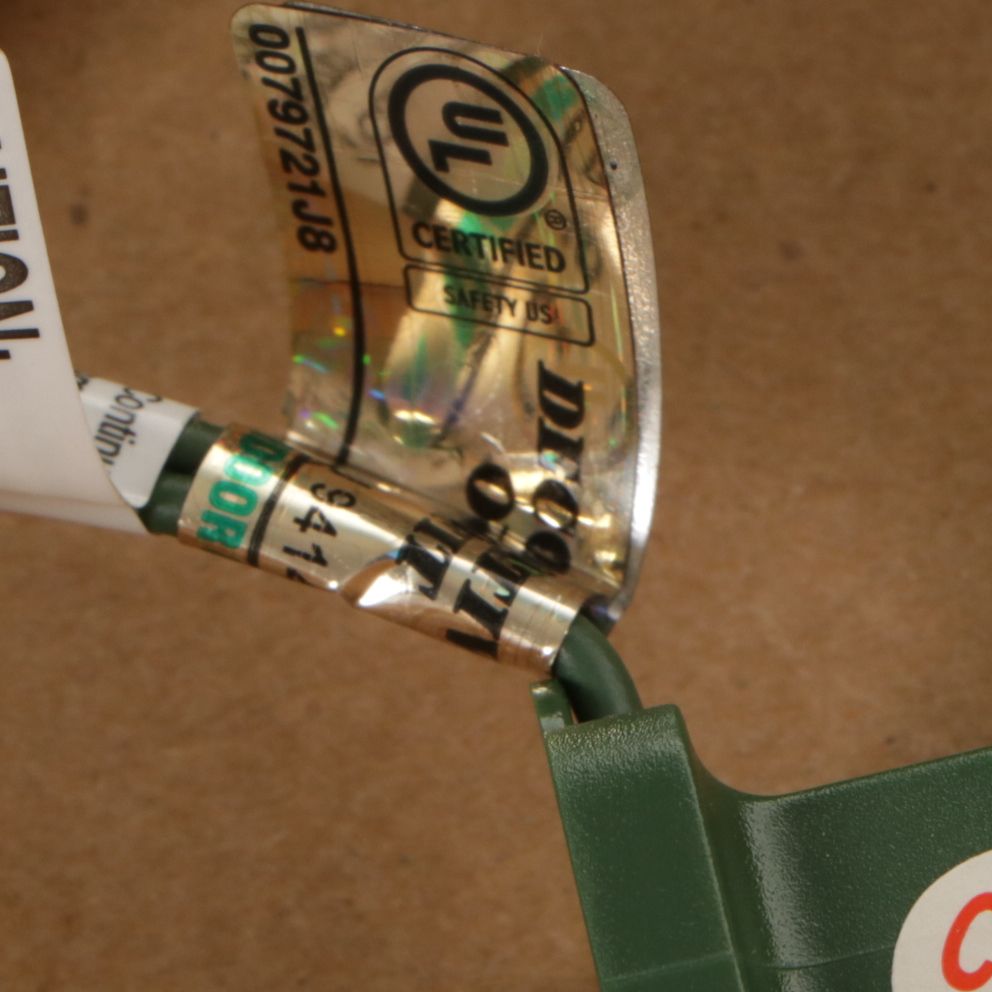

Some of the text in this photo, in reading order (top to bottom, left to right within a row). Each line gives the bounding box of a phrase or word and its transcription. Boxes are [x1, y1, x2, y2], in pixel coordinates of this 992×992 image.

[249, 23, 338, 255] 0079721J8
[427, 101, 509, 173] UL
[411, 221, 566, 273] CERTIFIED
[443, 284, 517, 317] SAFETY
